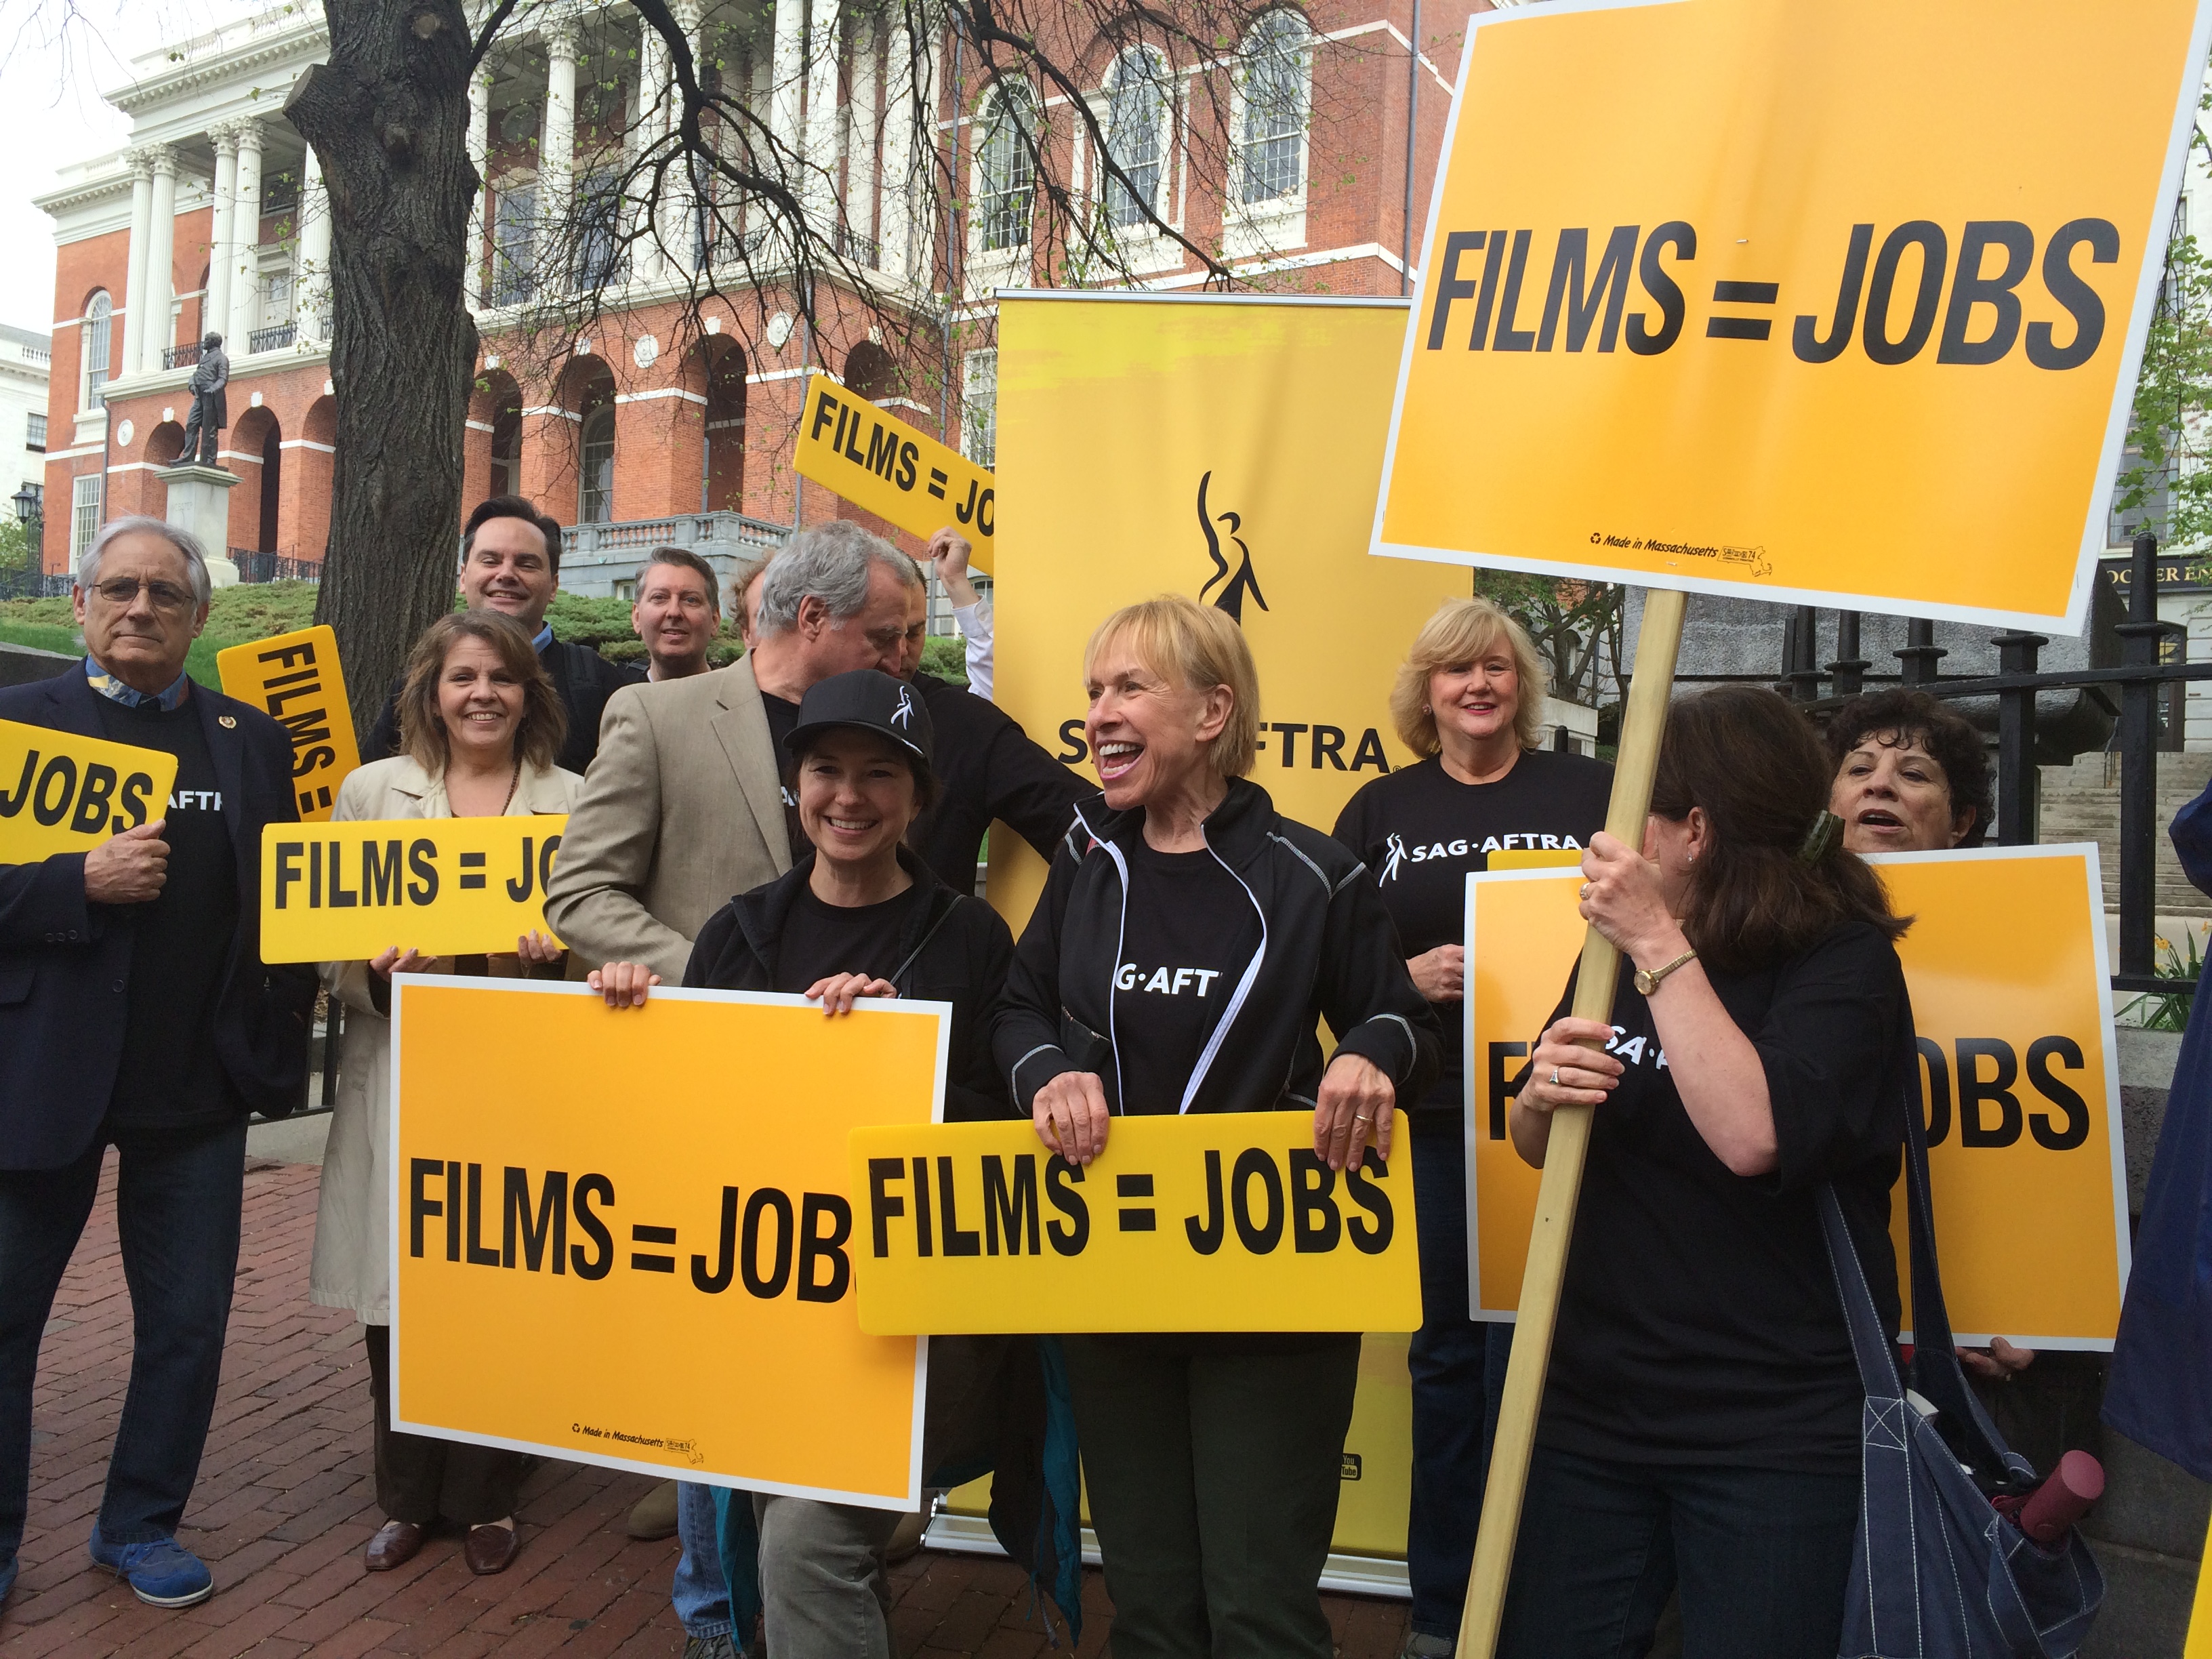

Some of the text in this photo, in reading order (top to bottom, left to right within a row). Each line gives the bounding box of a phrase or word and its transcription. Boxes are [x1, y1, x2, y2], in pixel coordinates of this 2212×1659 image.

[1428, 221, 1697, 356] FILMS
[1793, 218, 2120, 371] JOBS
[811, 391, 919, 491] FILMS
[1603, 535, 1631, 549] Made
[1632, 537, 1643, 550] in
[1644, 539, 1719, 558] Massachusetts
[258, 642, 335, 779] FILMS
[0, 750, 153, 836] JOBS
[275, 838, 439, 909] FILMS
[1915, 1036, 2089, 1151] OBS
[411, 1158, 615, 1281] FILMS
[691, 1186, 857, 1303] JOB
[868, 1152, 1090, 1258] FILMS
[1185, 1145, 1394, 1255] JOBS
[582, 1426, 602, 1437] Made
[603, 1429, 611, 1439] in
[612, 1431, 663, 1448] Massachusetts
[1341, 1467, 1356, 1476] Tube
[1343, 1455, 1355, 1465] You
